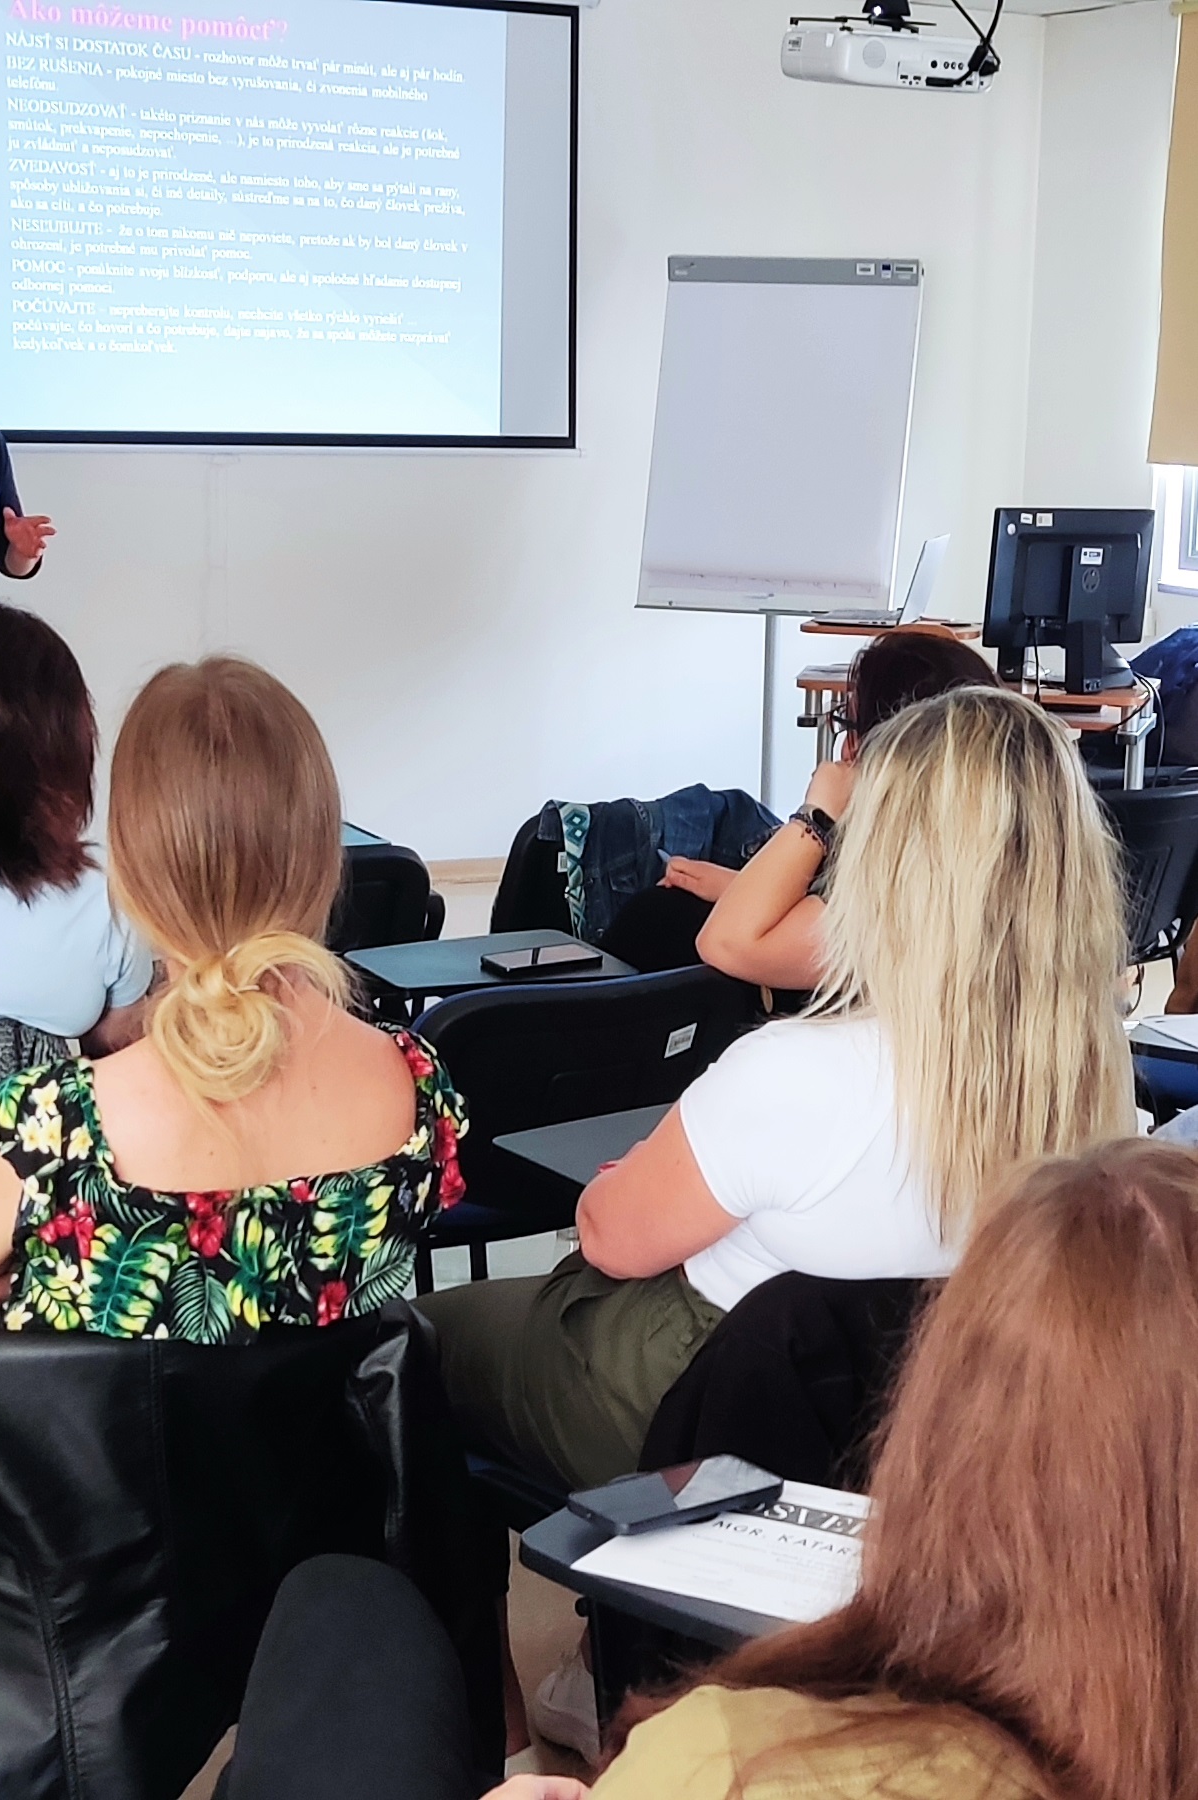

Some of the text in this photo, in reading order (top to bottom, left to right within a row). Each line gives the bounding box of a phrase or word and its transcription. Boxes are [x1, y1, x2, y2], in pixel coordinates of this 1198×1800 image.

[10, 0, 289, 43] Ako môžeme pomôcť?
[6, 30, 50, 50] NÁJSŤ
[56, 37, 68, 51] SI
[73, 38, 149, 58] DOSTATOK
[153, 42, 191, 61] ČASU
[204, 50, 255, 66] rozhovor
[258, 55, 288, 69] môže
[292, 58, 319, 71] trvať
[322, 60, 341, 76] pár
[343, 61, 377, 77] minút,
[381, 64, 397, 77] ale
[400, 66, 410, 82] aj
[413, 67, 430, 83] pár
[7, 55, 428, 101] BEZ RUŠENIA pokojné miesto bez vyrušovania, či zvonenia mobilného
[7, 97, 127, 119] NEODSUDZOVAŤ
[140, 107, 176, 122] takéto
[179, 111, 231, 127] priznanie
[235, 116, 242, 127] v
[245, 115, 265, 128] nás
[268, 117, 298, 131] môže
[301, 120, 343, 135] vyvolať
[380, 125, 419, 139] reakcie
[422, 128, 448, 143] (šok,
[7, 136, 20, 152] ju
[24, 137, 78, 153] zvládnuť
[92, 143, 177, 159] neposudzovať.
[8, 118, 460, 160] smútok, prekvapenie, nepochopenie, je to prirodzená reakcia, ale je potrebné
[9, 159, 96, 176] ZVEDAVOSŤ
[109, 165, 120, 181] aj
[124, 166, 135, 178] to
[137, 166, 149, 182] je
[152, 167, 217, 184] prirodzené,
[220, 171, 237, 184] ale
[240, 173, 290, 187] namiesto
[294, 175, 322, 191] toho,
[324, 177, 344, 194] aby
[347, 181, 369, 192] sme
[386, 182, 416, 197] pýtali
[419, 185, 432, 196] na
[435, 188, 460, 200] rany,
[10, 178, 59, 196] spôsoby
[135, 185, 148, 199] si,
[152, 186, 162, 198] či
[187, 187, 227, 205] detaily,
[307, 196, 320, 207] na
[324, 196, 338, 209] to,
[341, 196, 355, 208] čo
[357, 197, 382, 213] daný
[385, 199, 421, 212] človek
[10, 195, 33, 209] ako
[88, 200, 104, 213] čo
[69, 239, 82, 255] je
[85, 241, 136, 257] potrebné
[140, 245, 158, 255] mu
[162, 244, 208, 259] privolať
[119, 224, 133, 236] že
[135, 227, 144, 237] o
[146, 227, 169, 238] tom
[172, 226, 215, 240] nikomu
[219, 228, 236, 241] nič
[239, 233, 296, 246] nepoviete,
[300, 234, 340, 248] pretože
[342, 234, 355, 247] ak
[358, 234, 372, 251] by
[375, 235, 392, 249] bol
[395, 236, 420, 254] daný
[423, 238, 458, 252] človek
[461, 242, 468, 253] v
[12, 259, 65, 273] POMOC
[228, 268, 277, 285] podporu,
[280, 270, 296, 283] ale
[299, 272, 309, 287] aj
[412, 275, 461, 293] dostupnej
[12, 277, 64, 295] odbornej
